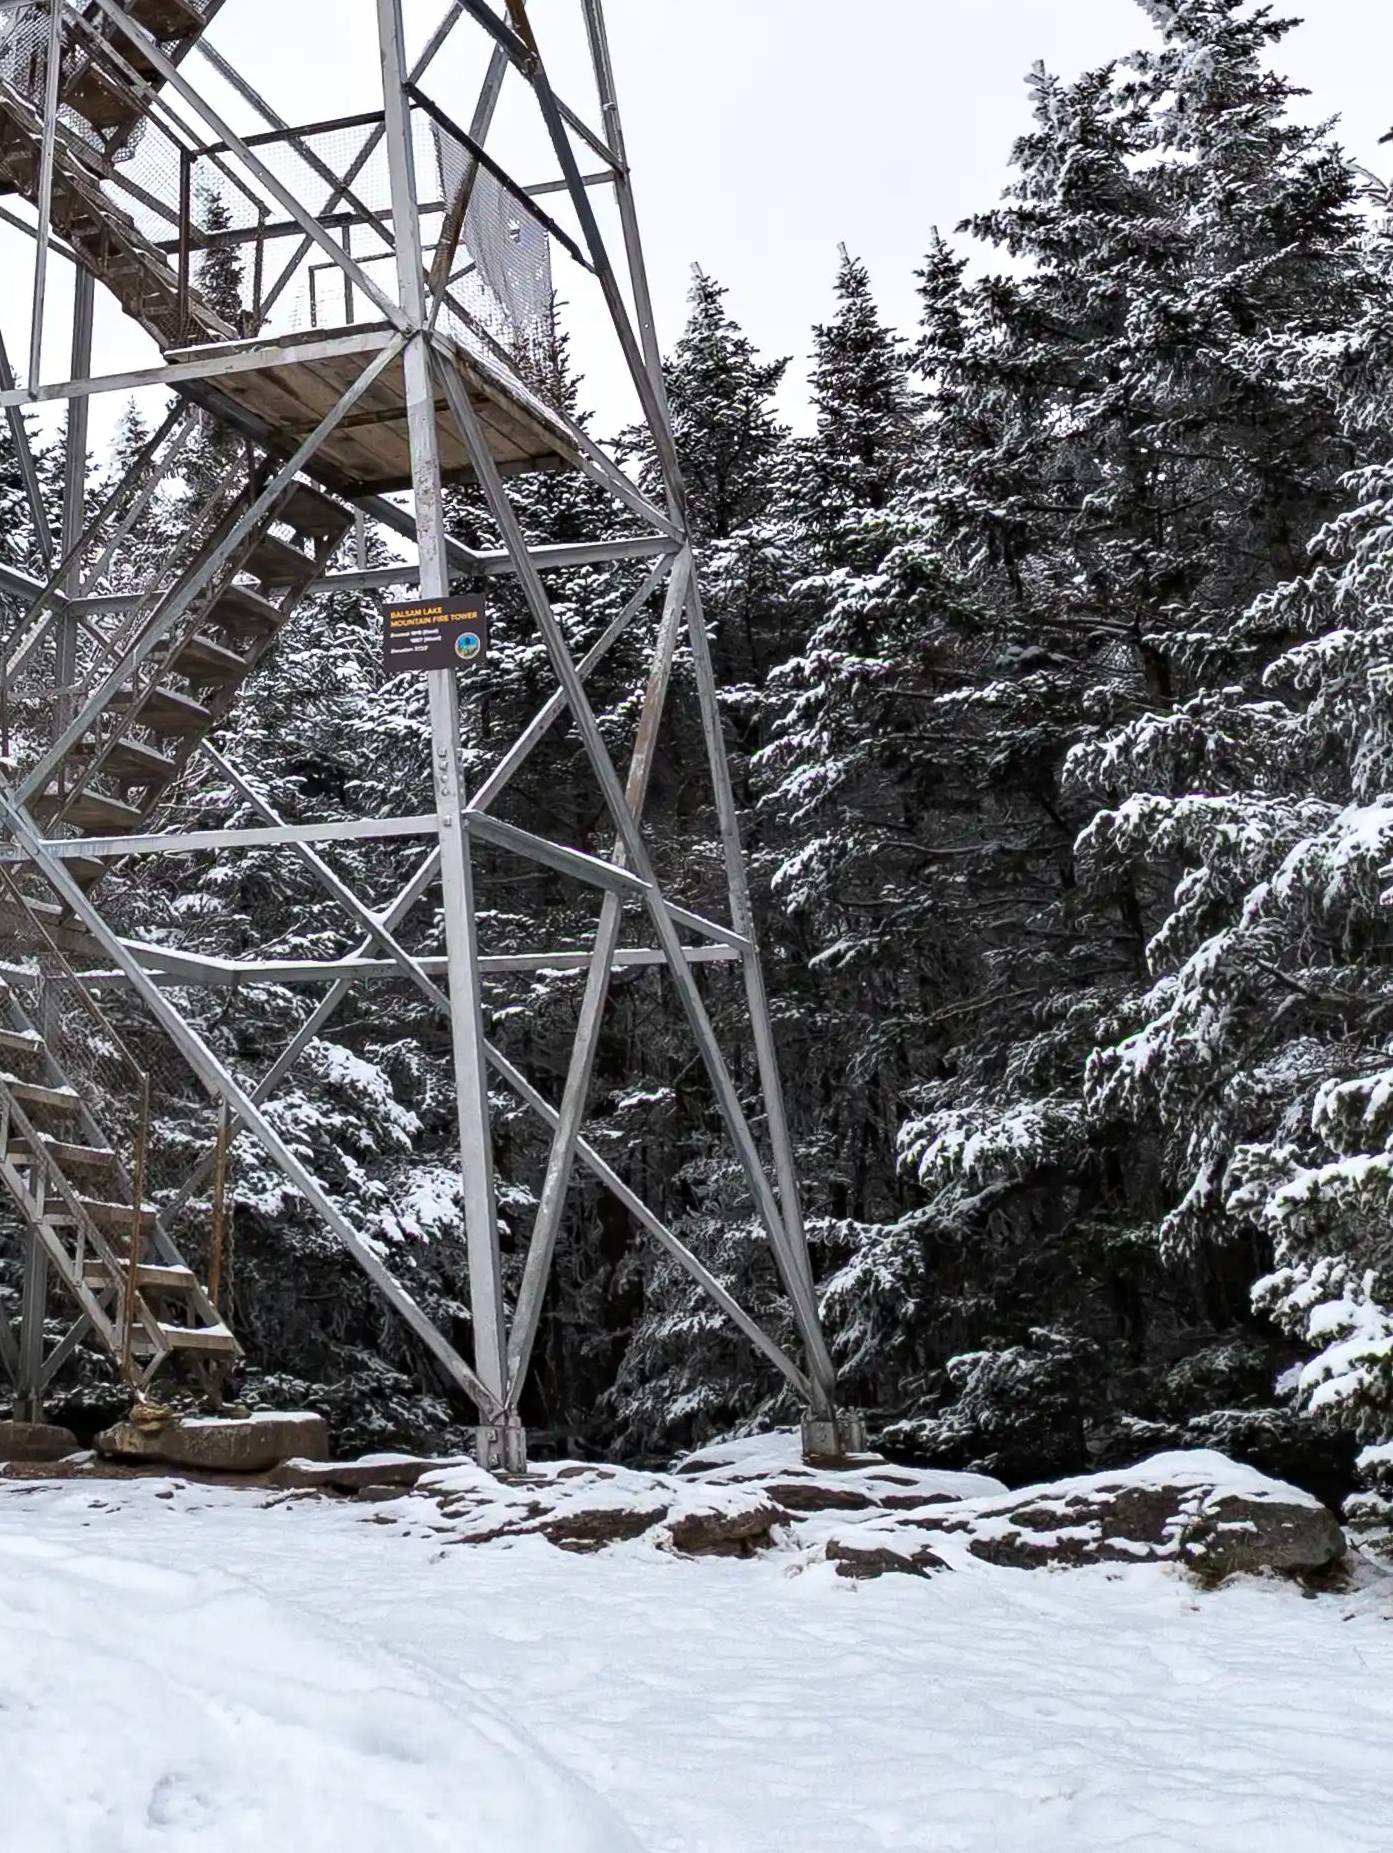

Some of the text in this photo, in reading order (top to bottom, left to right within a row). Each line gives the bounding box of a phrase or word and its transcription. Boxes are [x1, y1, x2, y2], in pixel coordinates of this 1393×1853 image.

[390, 607, 443, 619] BALSAM LAKE
[390, 611, 478, 627] MOUNTAIN FIRE TOWER
